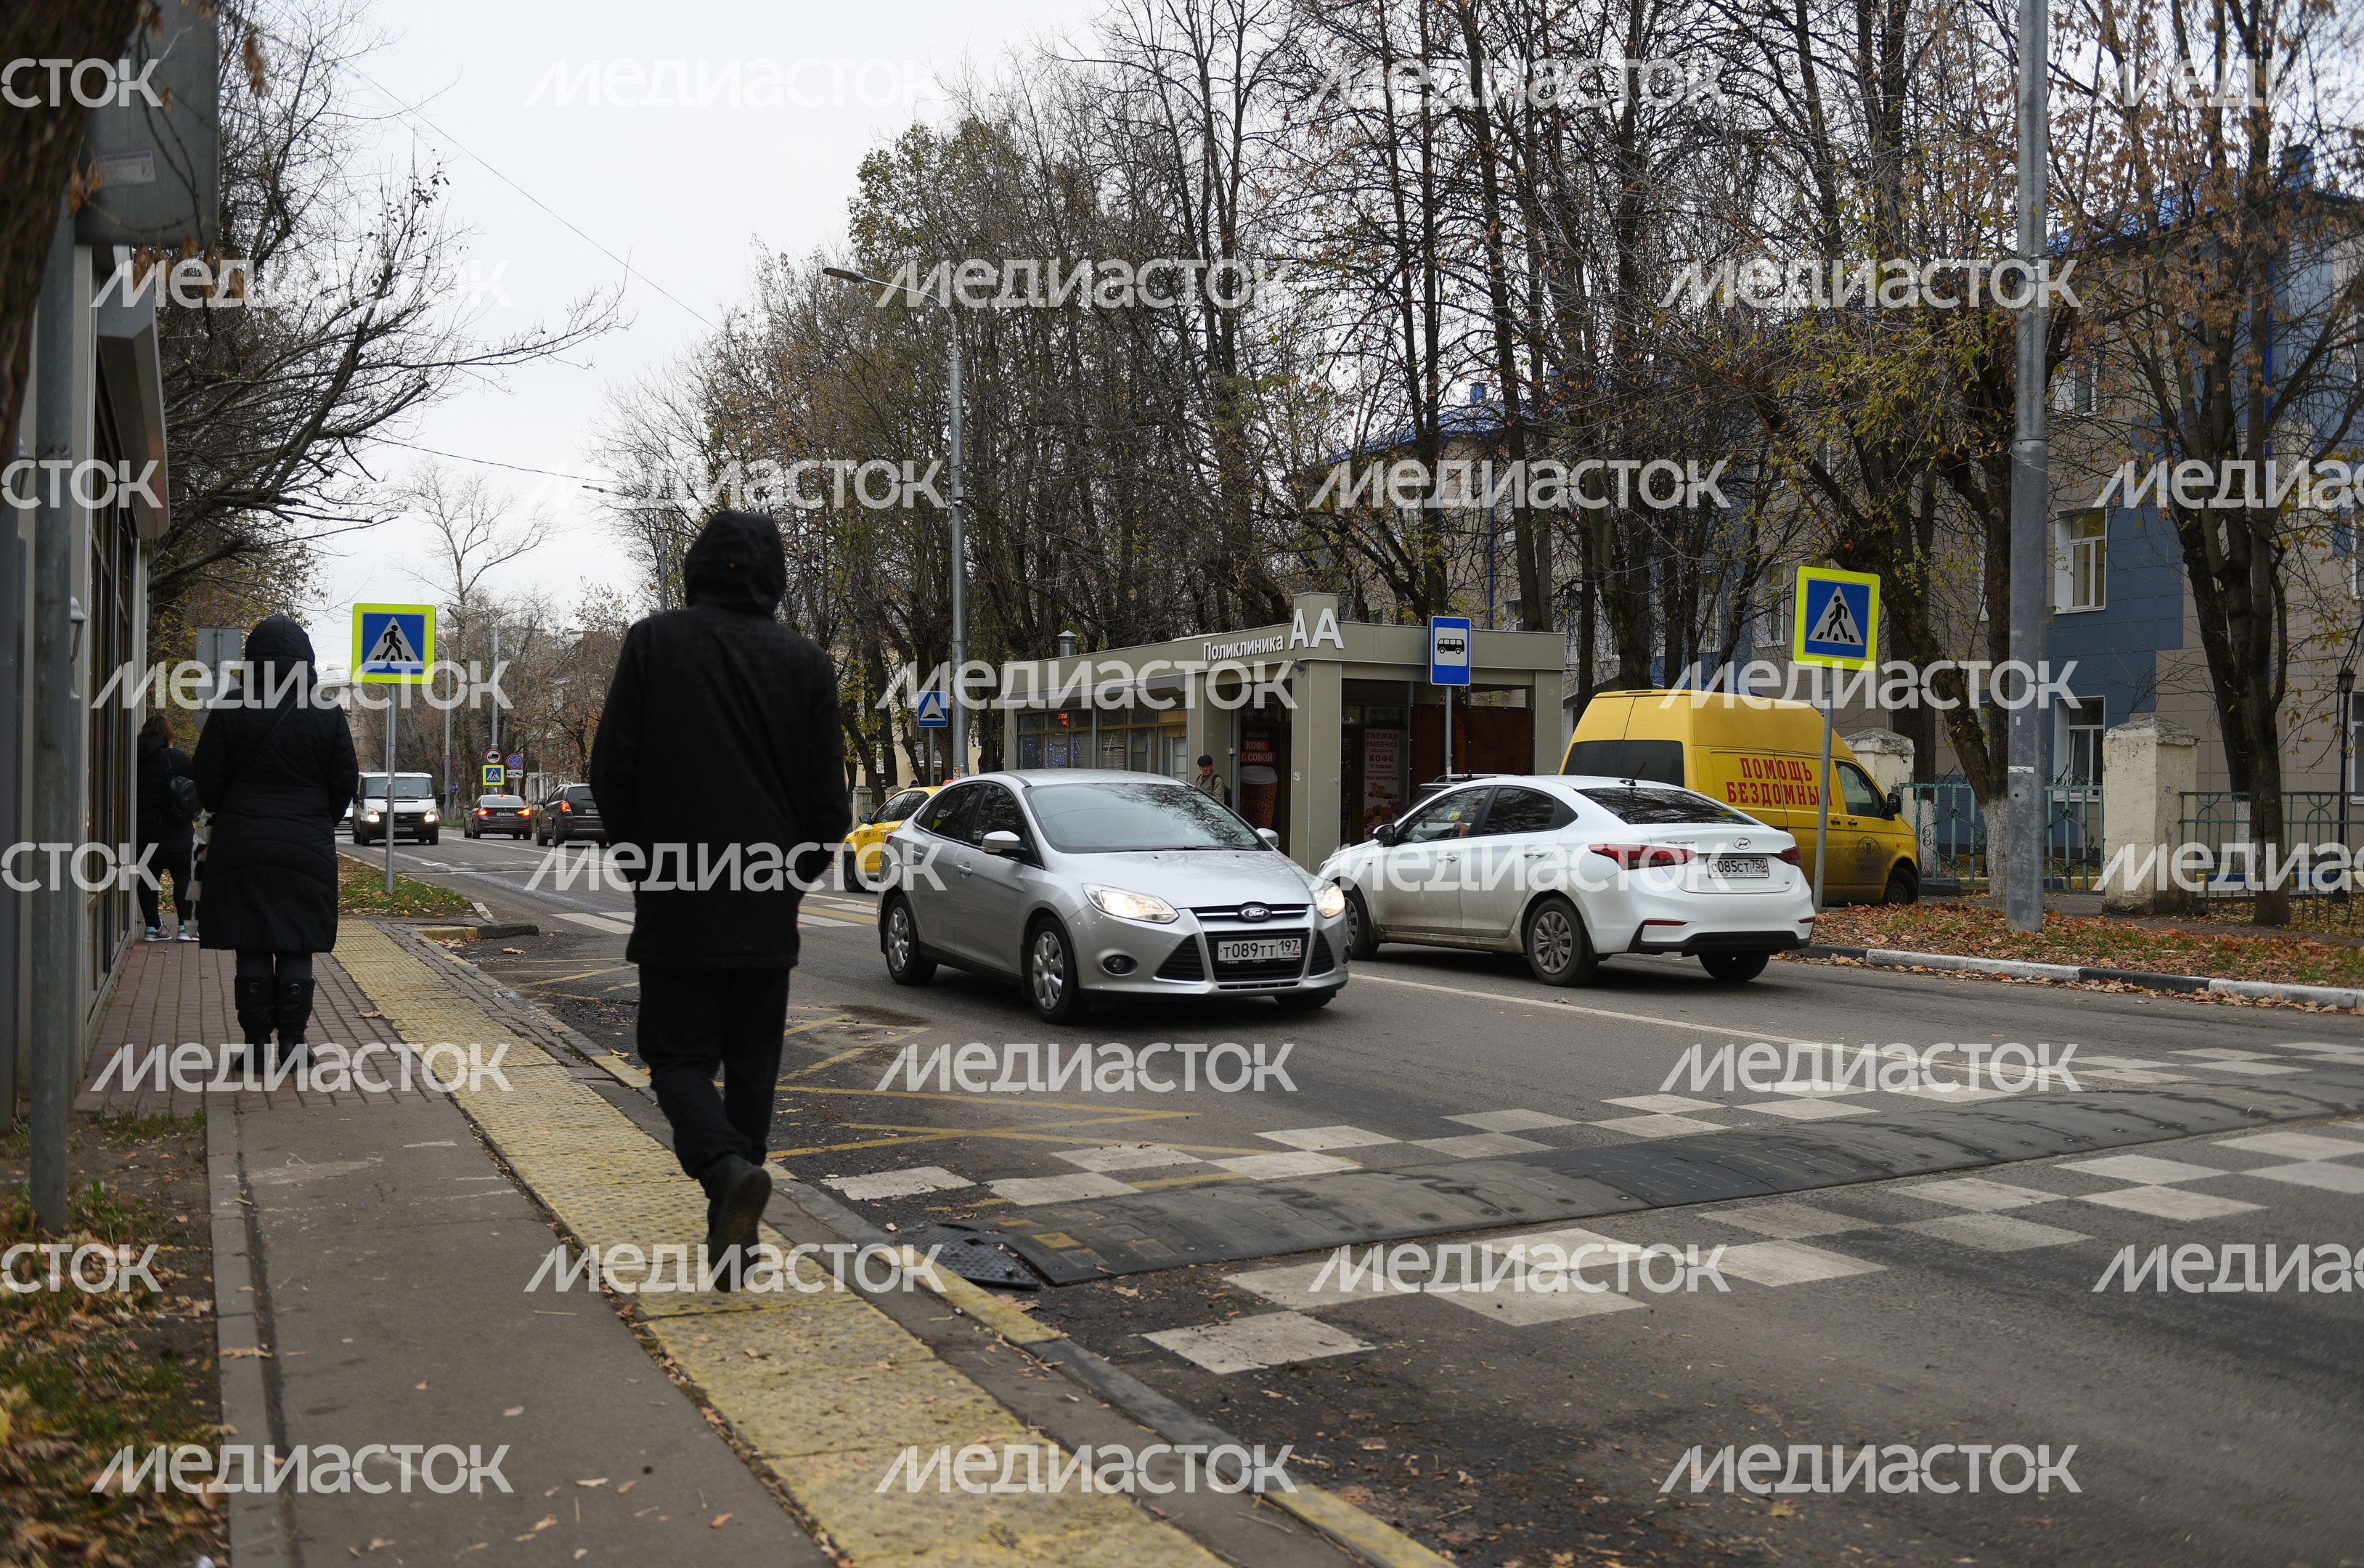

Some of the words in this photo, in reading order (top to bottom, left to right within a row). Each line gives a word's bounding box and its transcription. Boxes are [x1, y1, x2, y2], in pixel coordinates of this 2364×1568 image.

[1203, 634, 1284, 661] Поликлиника
[1246, 741, 1267, 750] КОФЕ
[1247, 752, 1273, 761] СОБОЙ
[1739, 757, 1813, 785] ПОМОЩЬ
[1750, 859, 1765, 870] 750
[1248, 908, 1265, 917] Ford
[1279, 940, 1298, 952] 197
